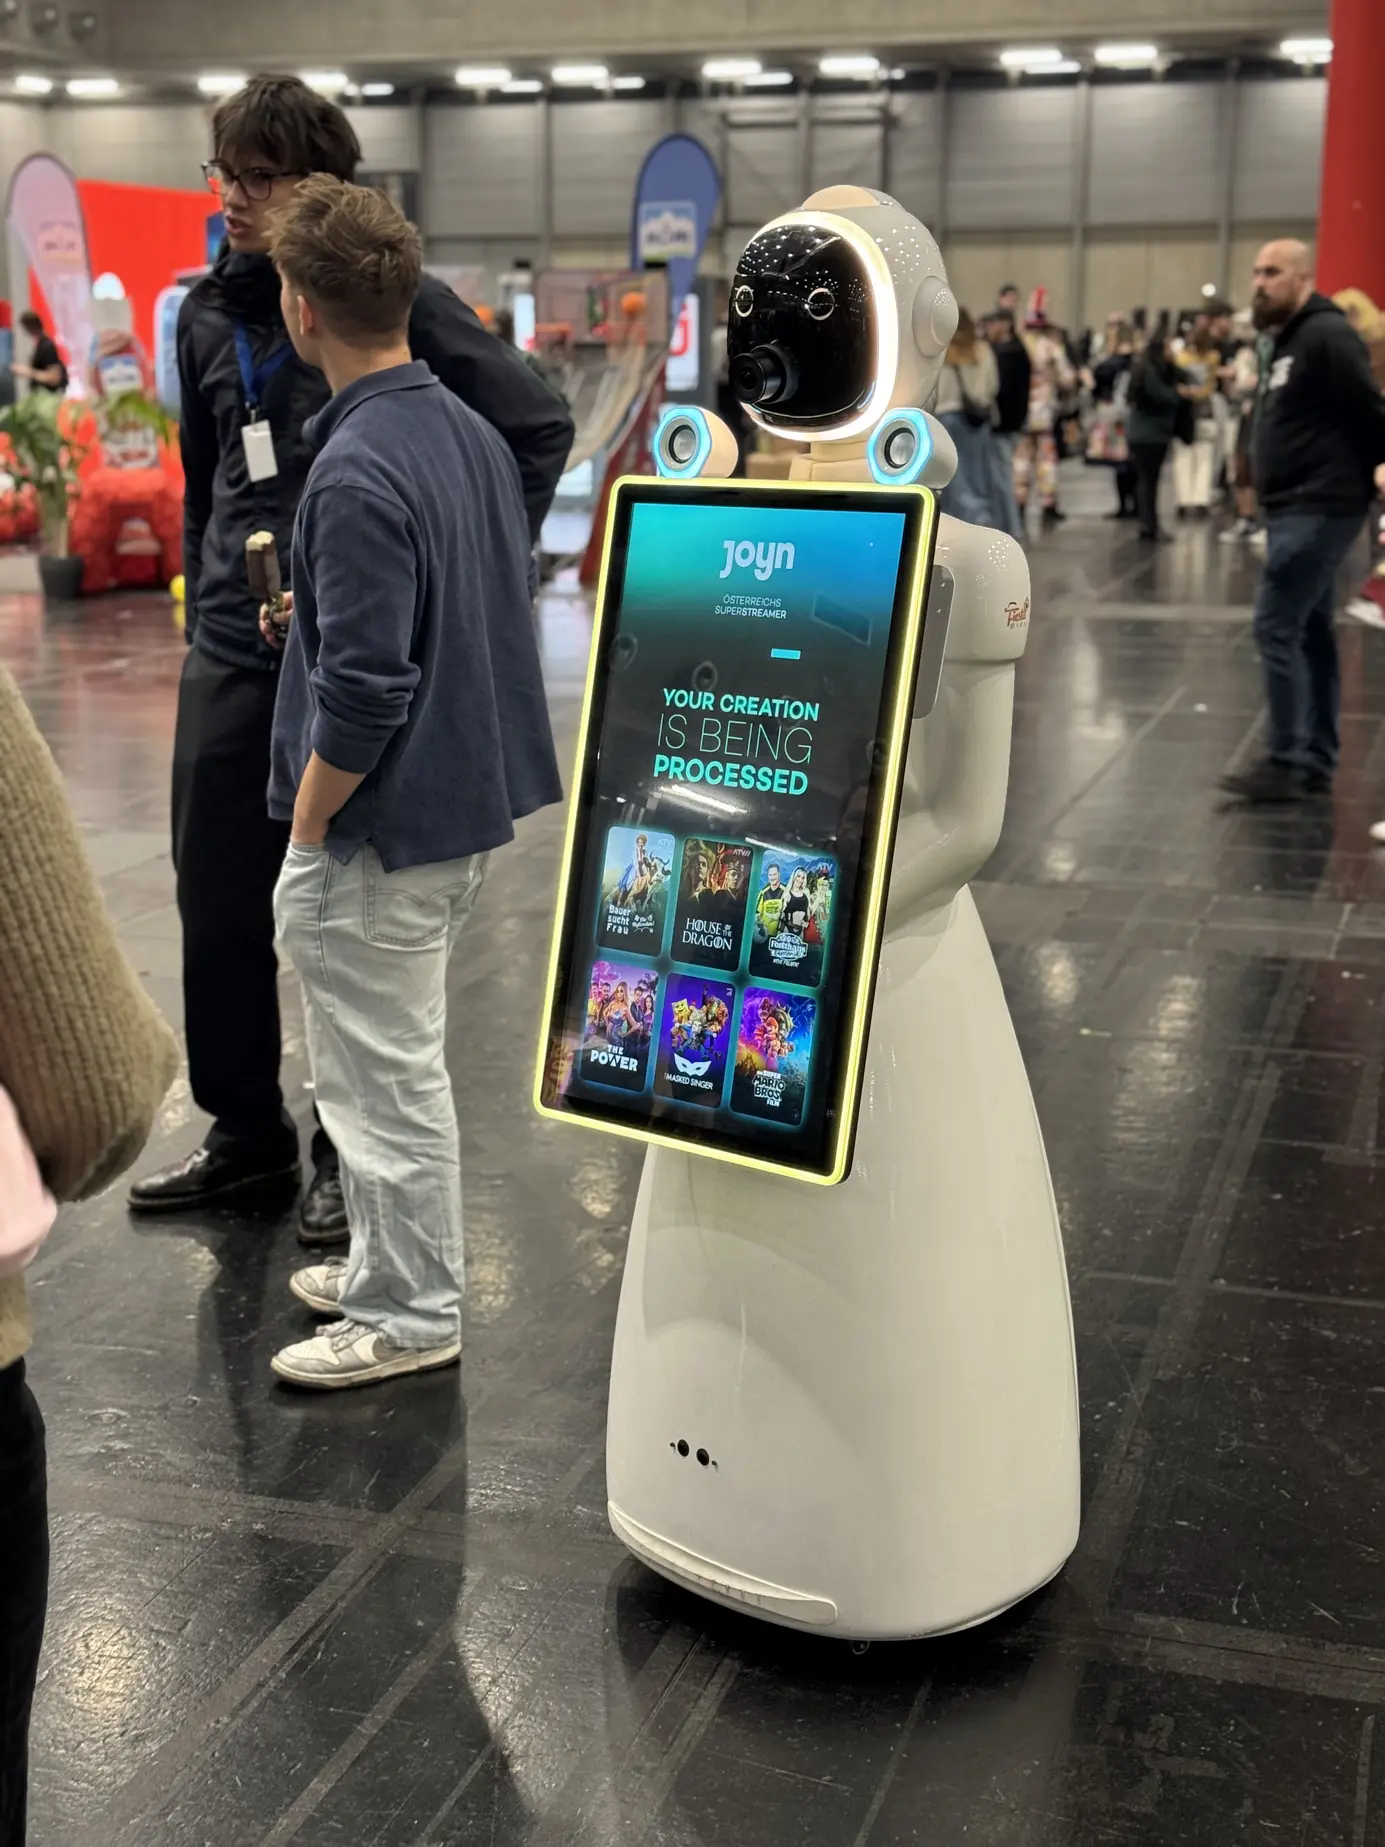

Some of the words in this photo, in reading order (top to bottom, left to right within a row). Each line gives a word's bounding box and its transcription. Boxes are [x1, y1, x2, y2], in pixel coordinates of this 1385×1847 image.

[723, 593, 782, 608] ÖSTERREICHS
[715, 605, 787, 619] SUPERSTREAMER
[663, 687, 715, 711] YOUR
[719, 693, 820, 722] CREATION
[657, 713, 688, 750] IS
[699, 717, 813, 764] BEING
[653, 753, 809, 796] PROCESSED
[609, 904, 631, 917] Bauer
[607, 914, 629, 926] sucht
[686, 917, 722, 935] HOUSE
[606, 923, 629, 935] Frau
[682, 930, 733, 951] DRAGON
[607, 1044, 624, 1055] THE
[590, 1050, 638, 1072] POWER
[666, 1074, 690, 1086] MASKED
[690, 1079, 714, 1091] SINGER
[752, 1074, 786, 1091] MARIO
